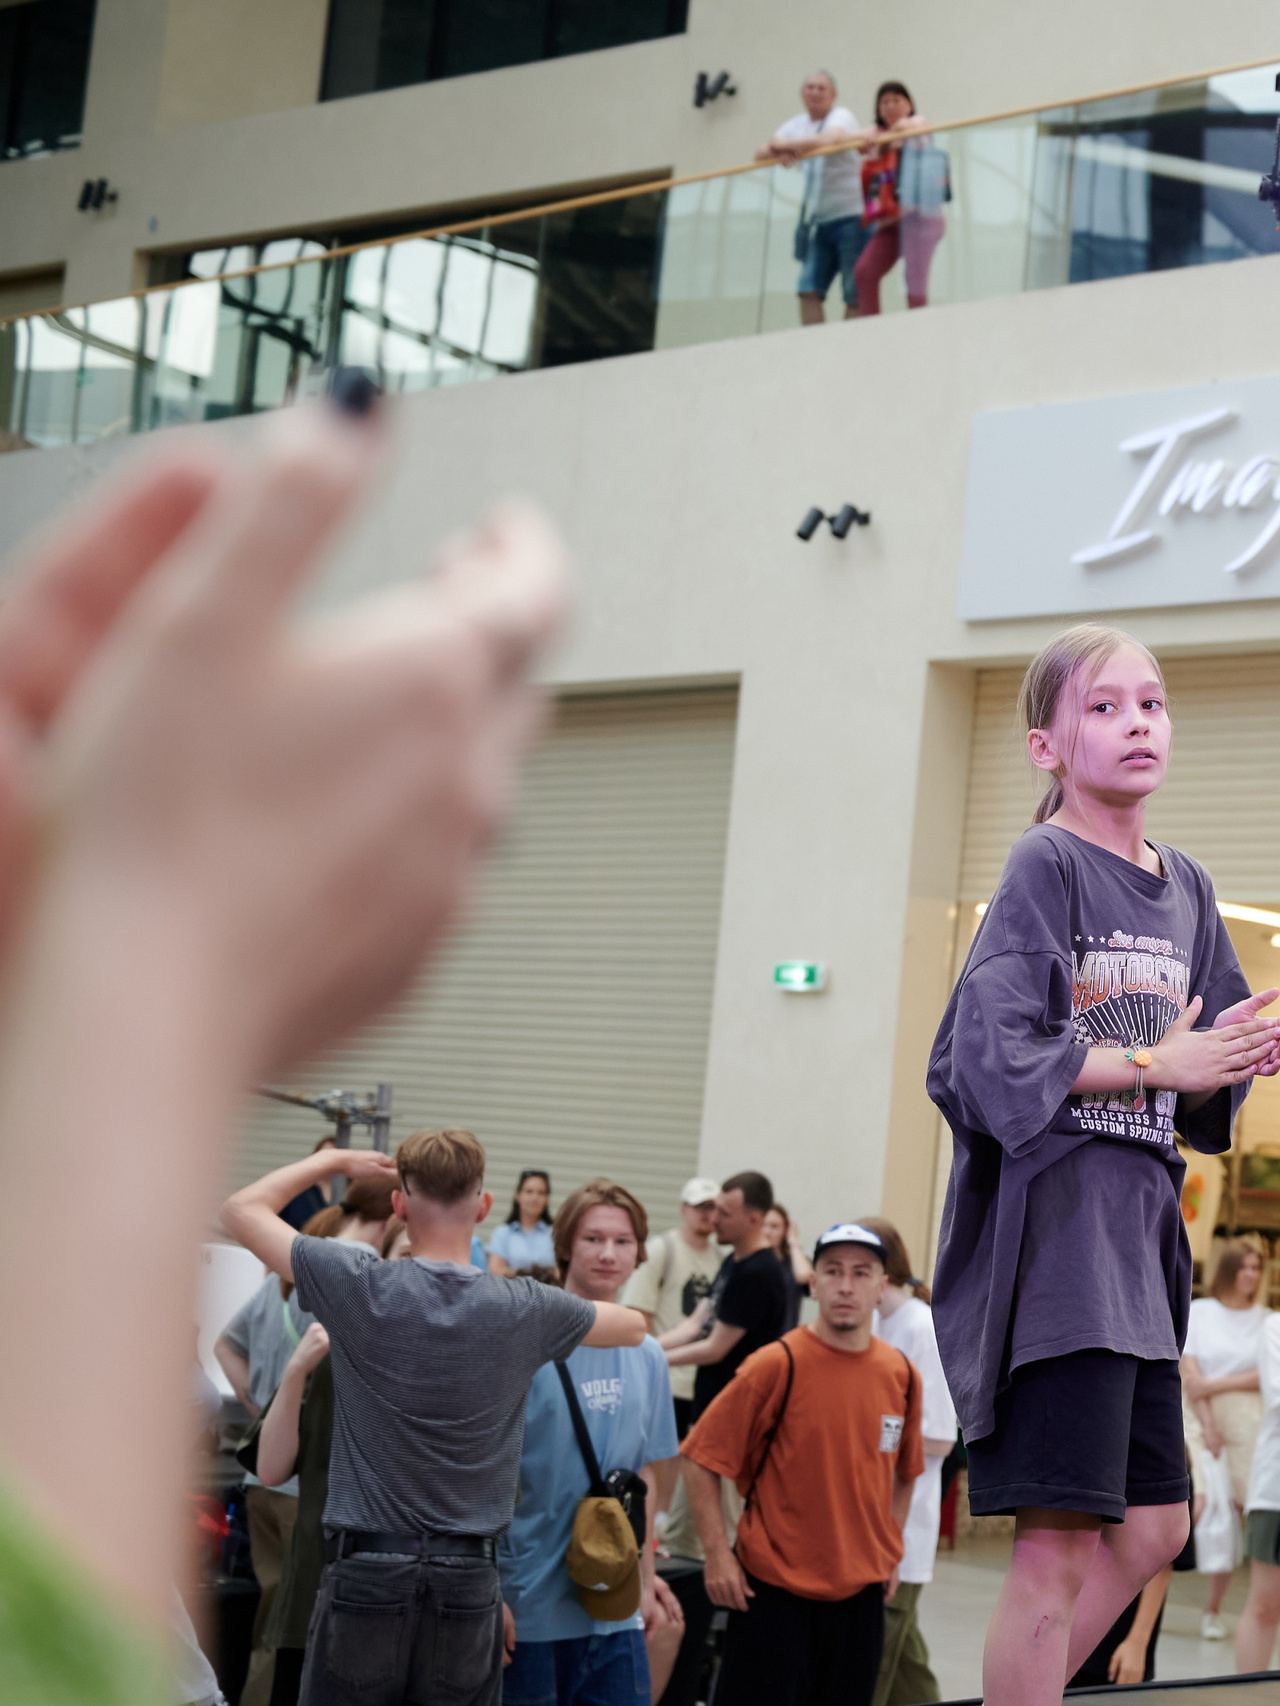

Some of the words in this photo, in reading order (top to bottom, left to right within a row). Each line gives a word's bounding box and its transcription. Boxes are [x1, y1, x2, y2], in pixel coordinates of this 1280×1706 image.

[1071, 1107, 1150, 1125] MOTOCROSS
[1080, 1119, 1125, 1135] CUSTOM
[1129, 1125, 1163, 1143] SPRING
